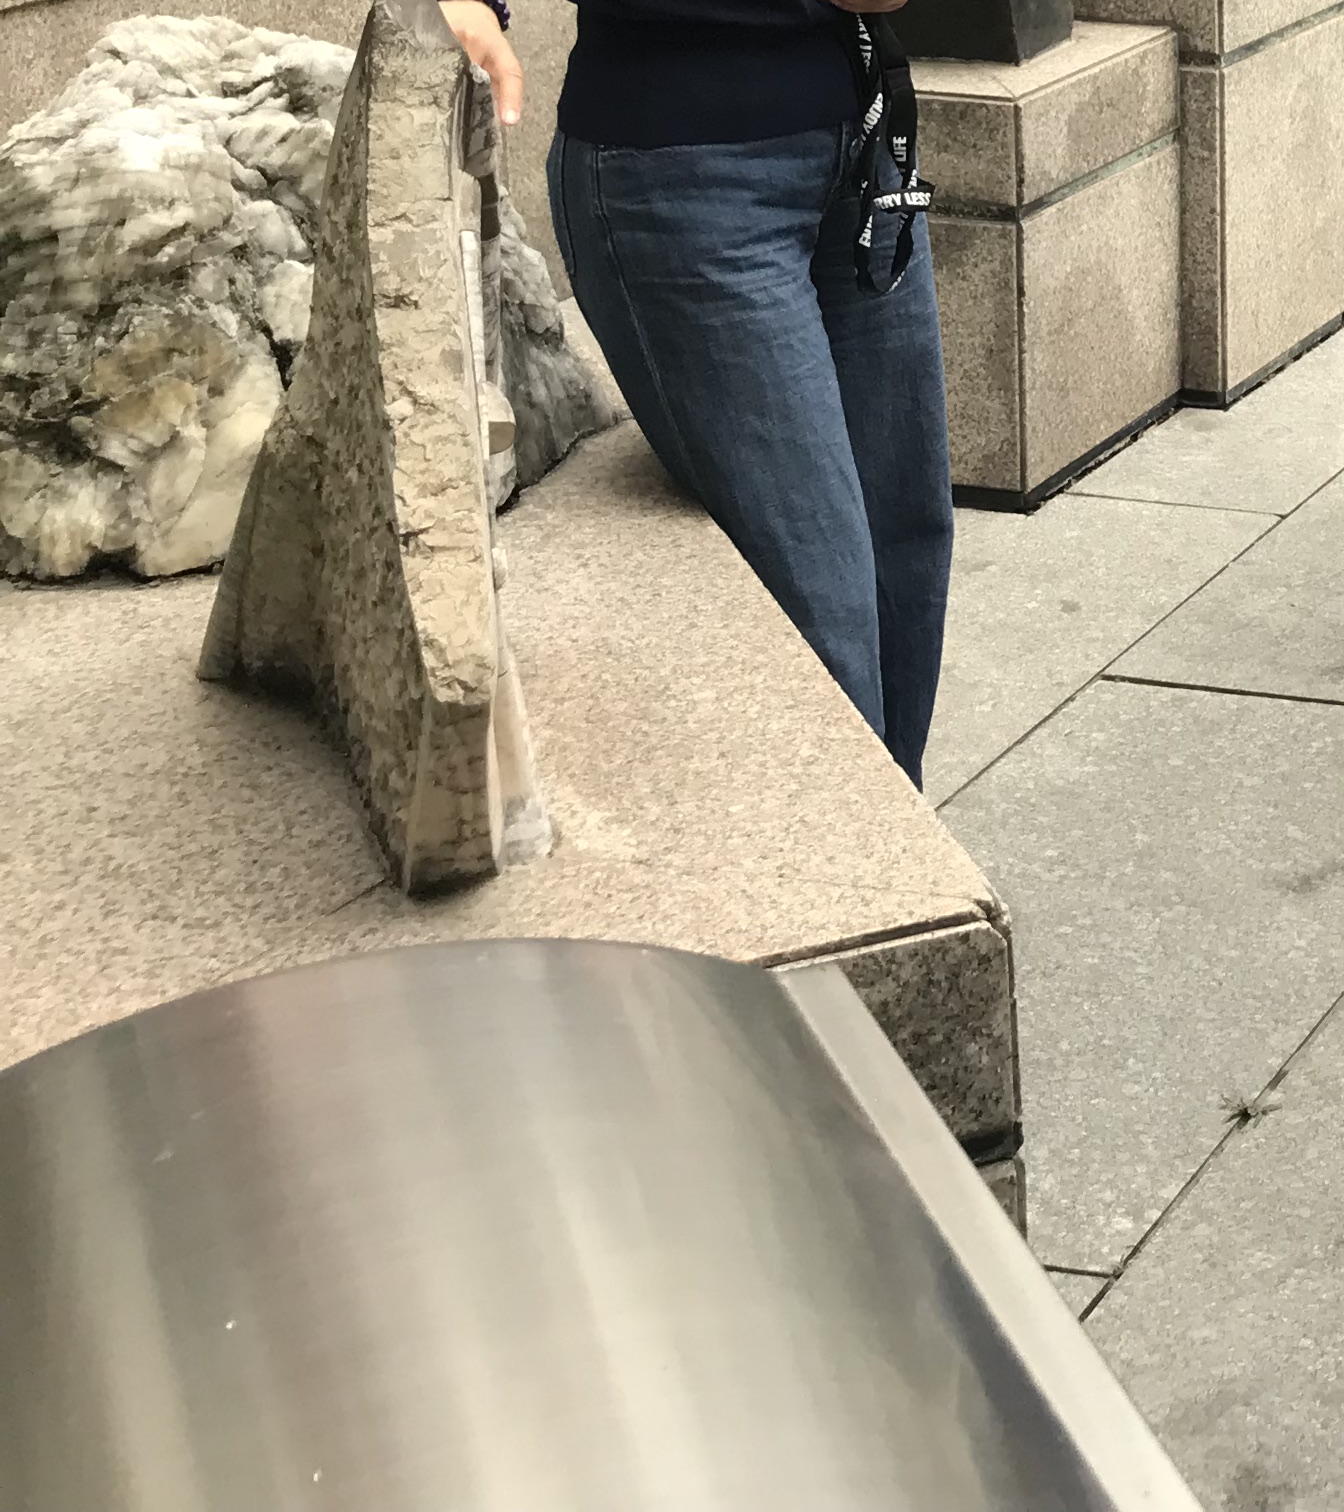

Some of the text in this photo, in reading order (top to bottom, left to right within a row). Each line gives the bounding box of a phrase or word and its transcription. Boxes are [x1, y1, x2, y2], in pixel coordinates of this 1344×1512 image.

[893, 136, 907, 162] LIFE
[873, 191, 932, 210] RRY LESS
